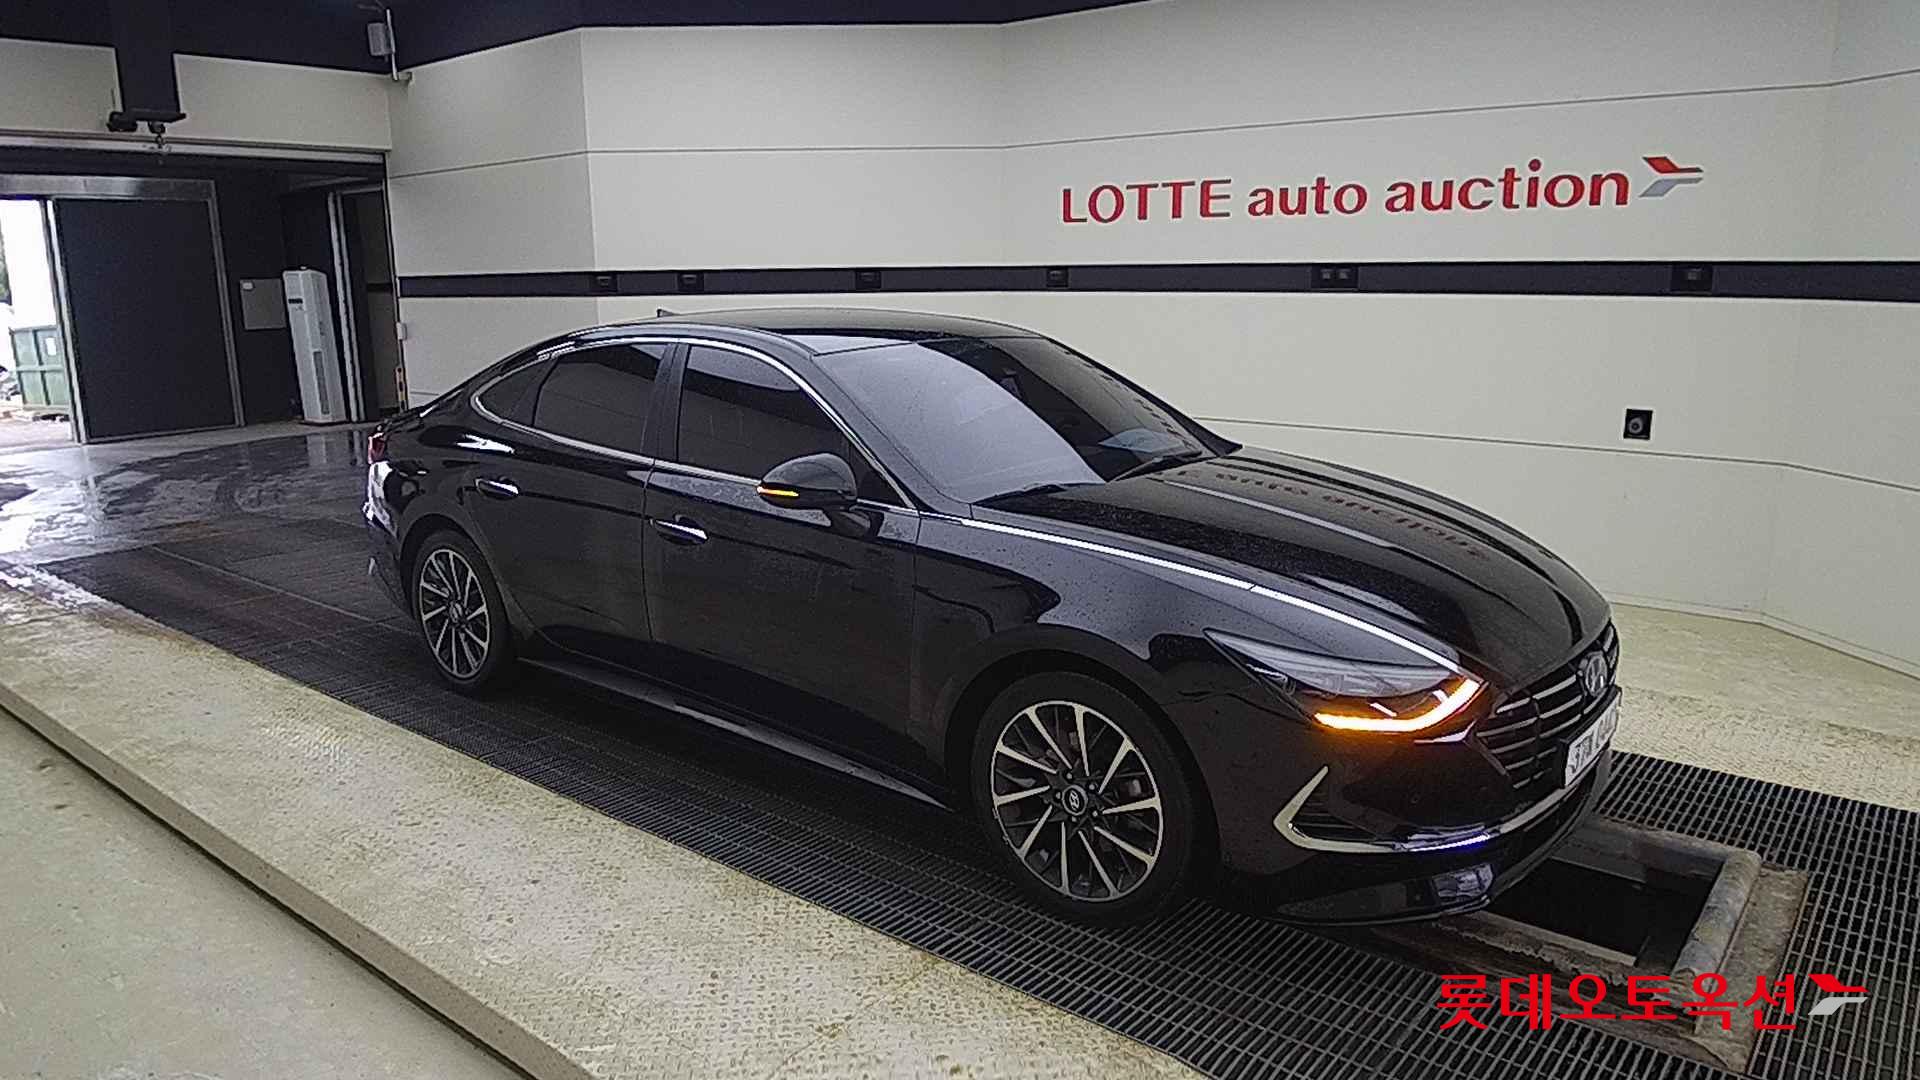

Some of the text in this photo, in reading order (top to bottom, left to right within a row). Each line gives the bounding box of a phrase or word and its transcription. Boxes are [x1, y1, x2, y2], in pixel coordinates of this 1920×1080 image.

[1062, 158, 1630, 224] LOTTE auto auction
